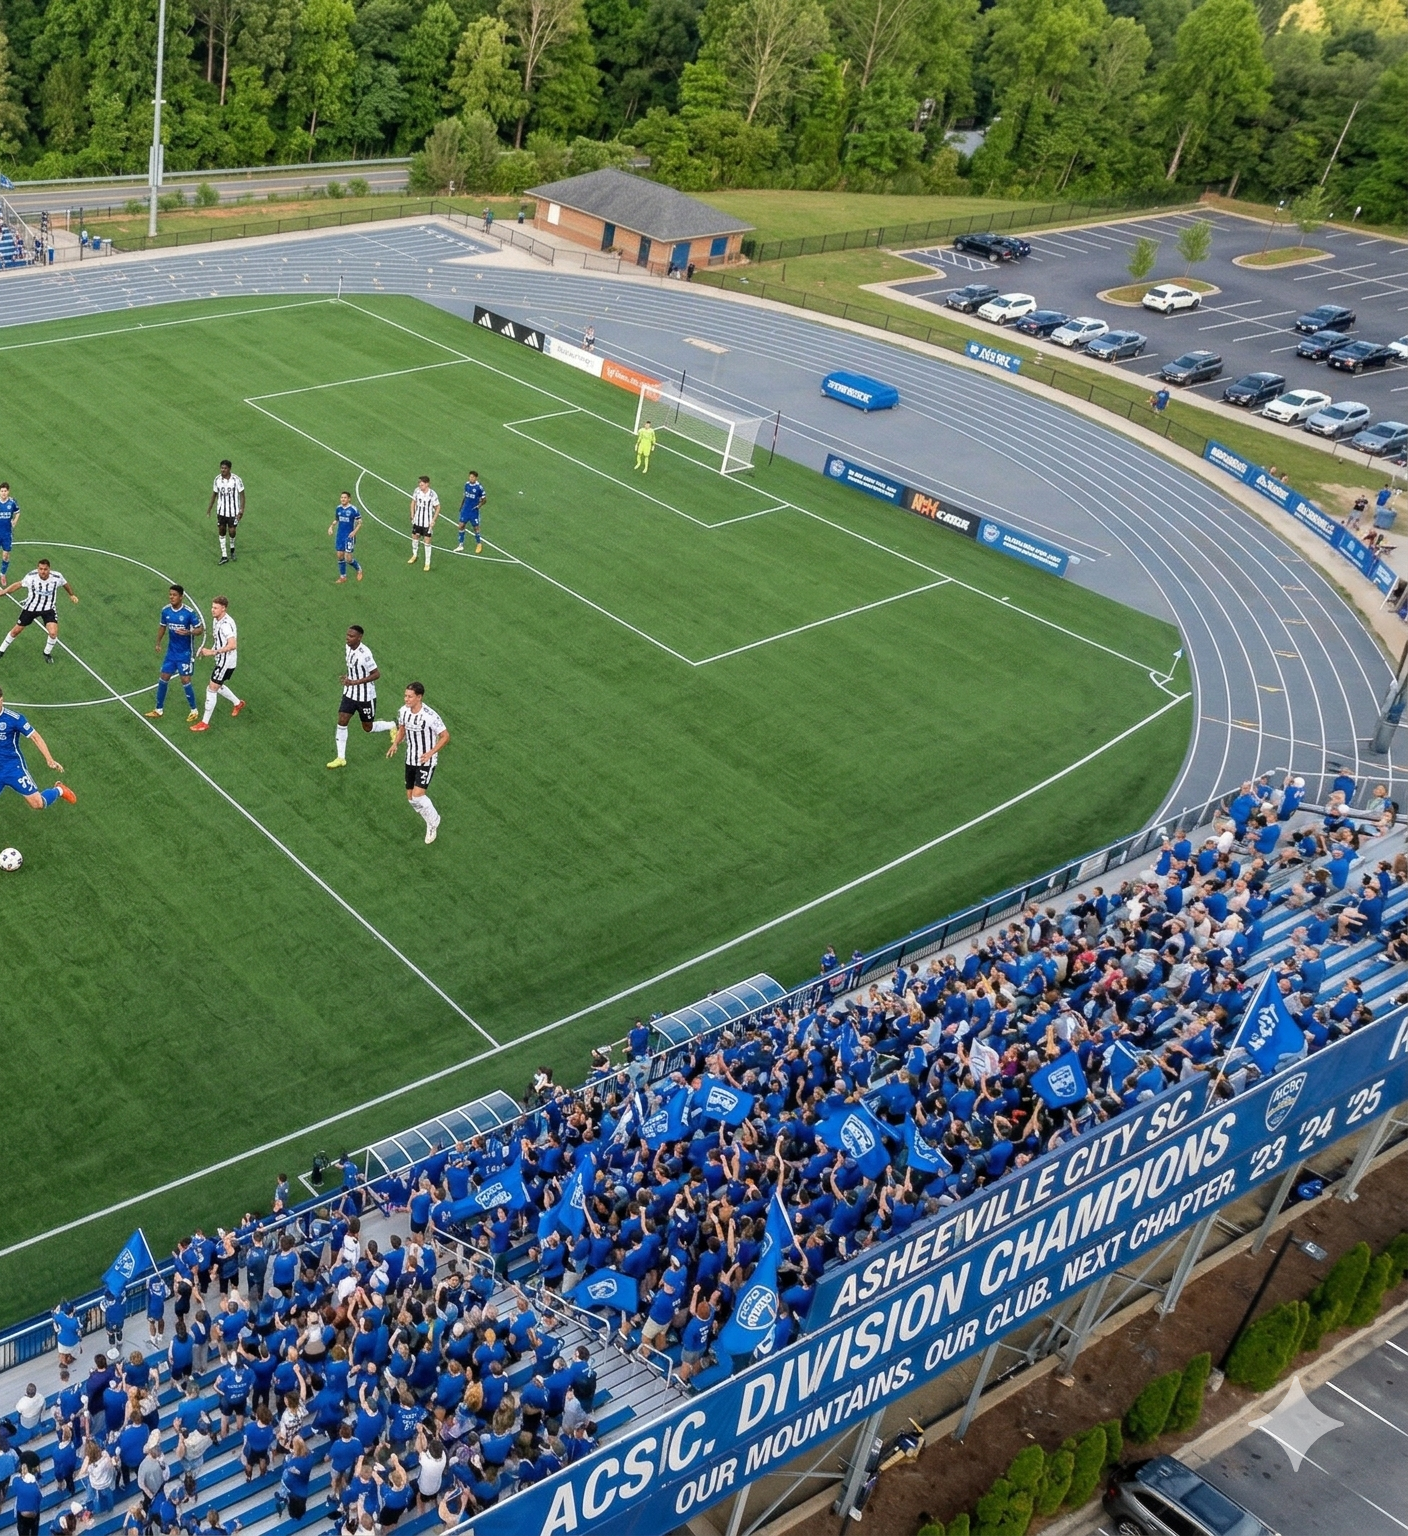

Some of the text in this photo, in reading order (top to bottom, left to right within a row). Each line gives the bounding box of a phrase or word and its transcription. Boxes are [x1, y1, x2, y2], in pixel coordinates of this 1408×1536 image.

[675, 1079, 1386, 1515] OUR MOUNTAINS. OUR CLUB. NEXT CHAPTER. '23 '24 '25
[736, 1261, 972, 1436] DIVISION
[979, 1112, 1236, 1297] CHAMPIONS
[1063, 1115, 1144, 1186] CITY
[1146, 1090, 1193, 1142] SC
